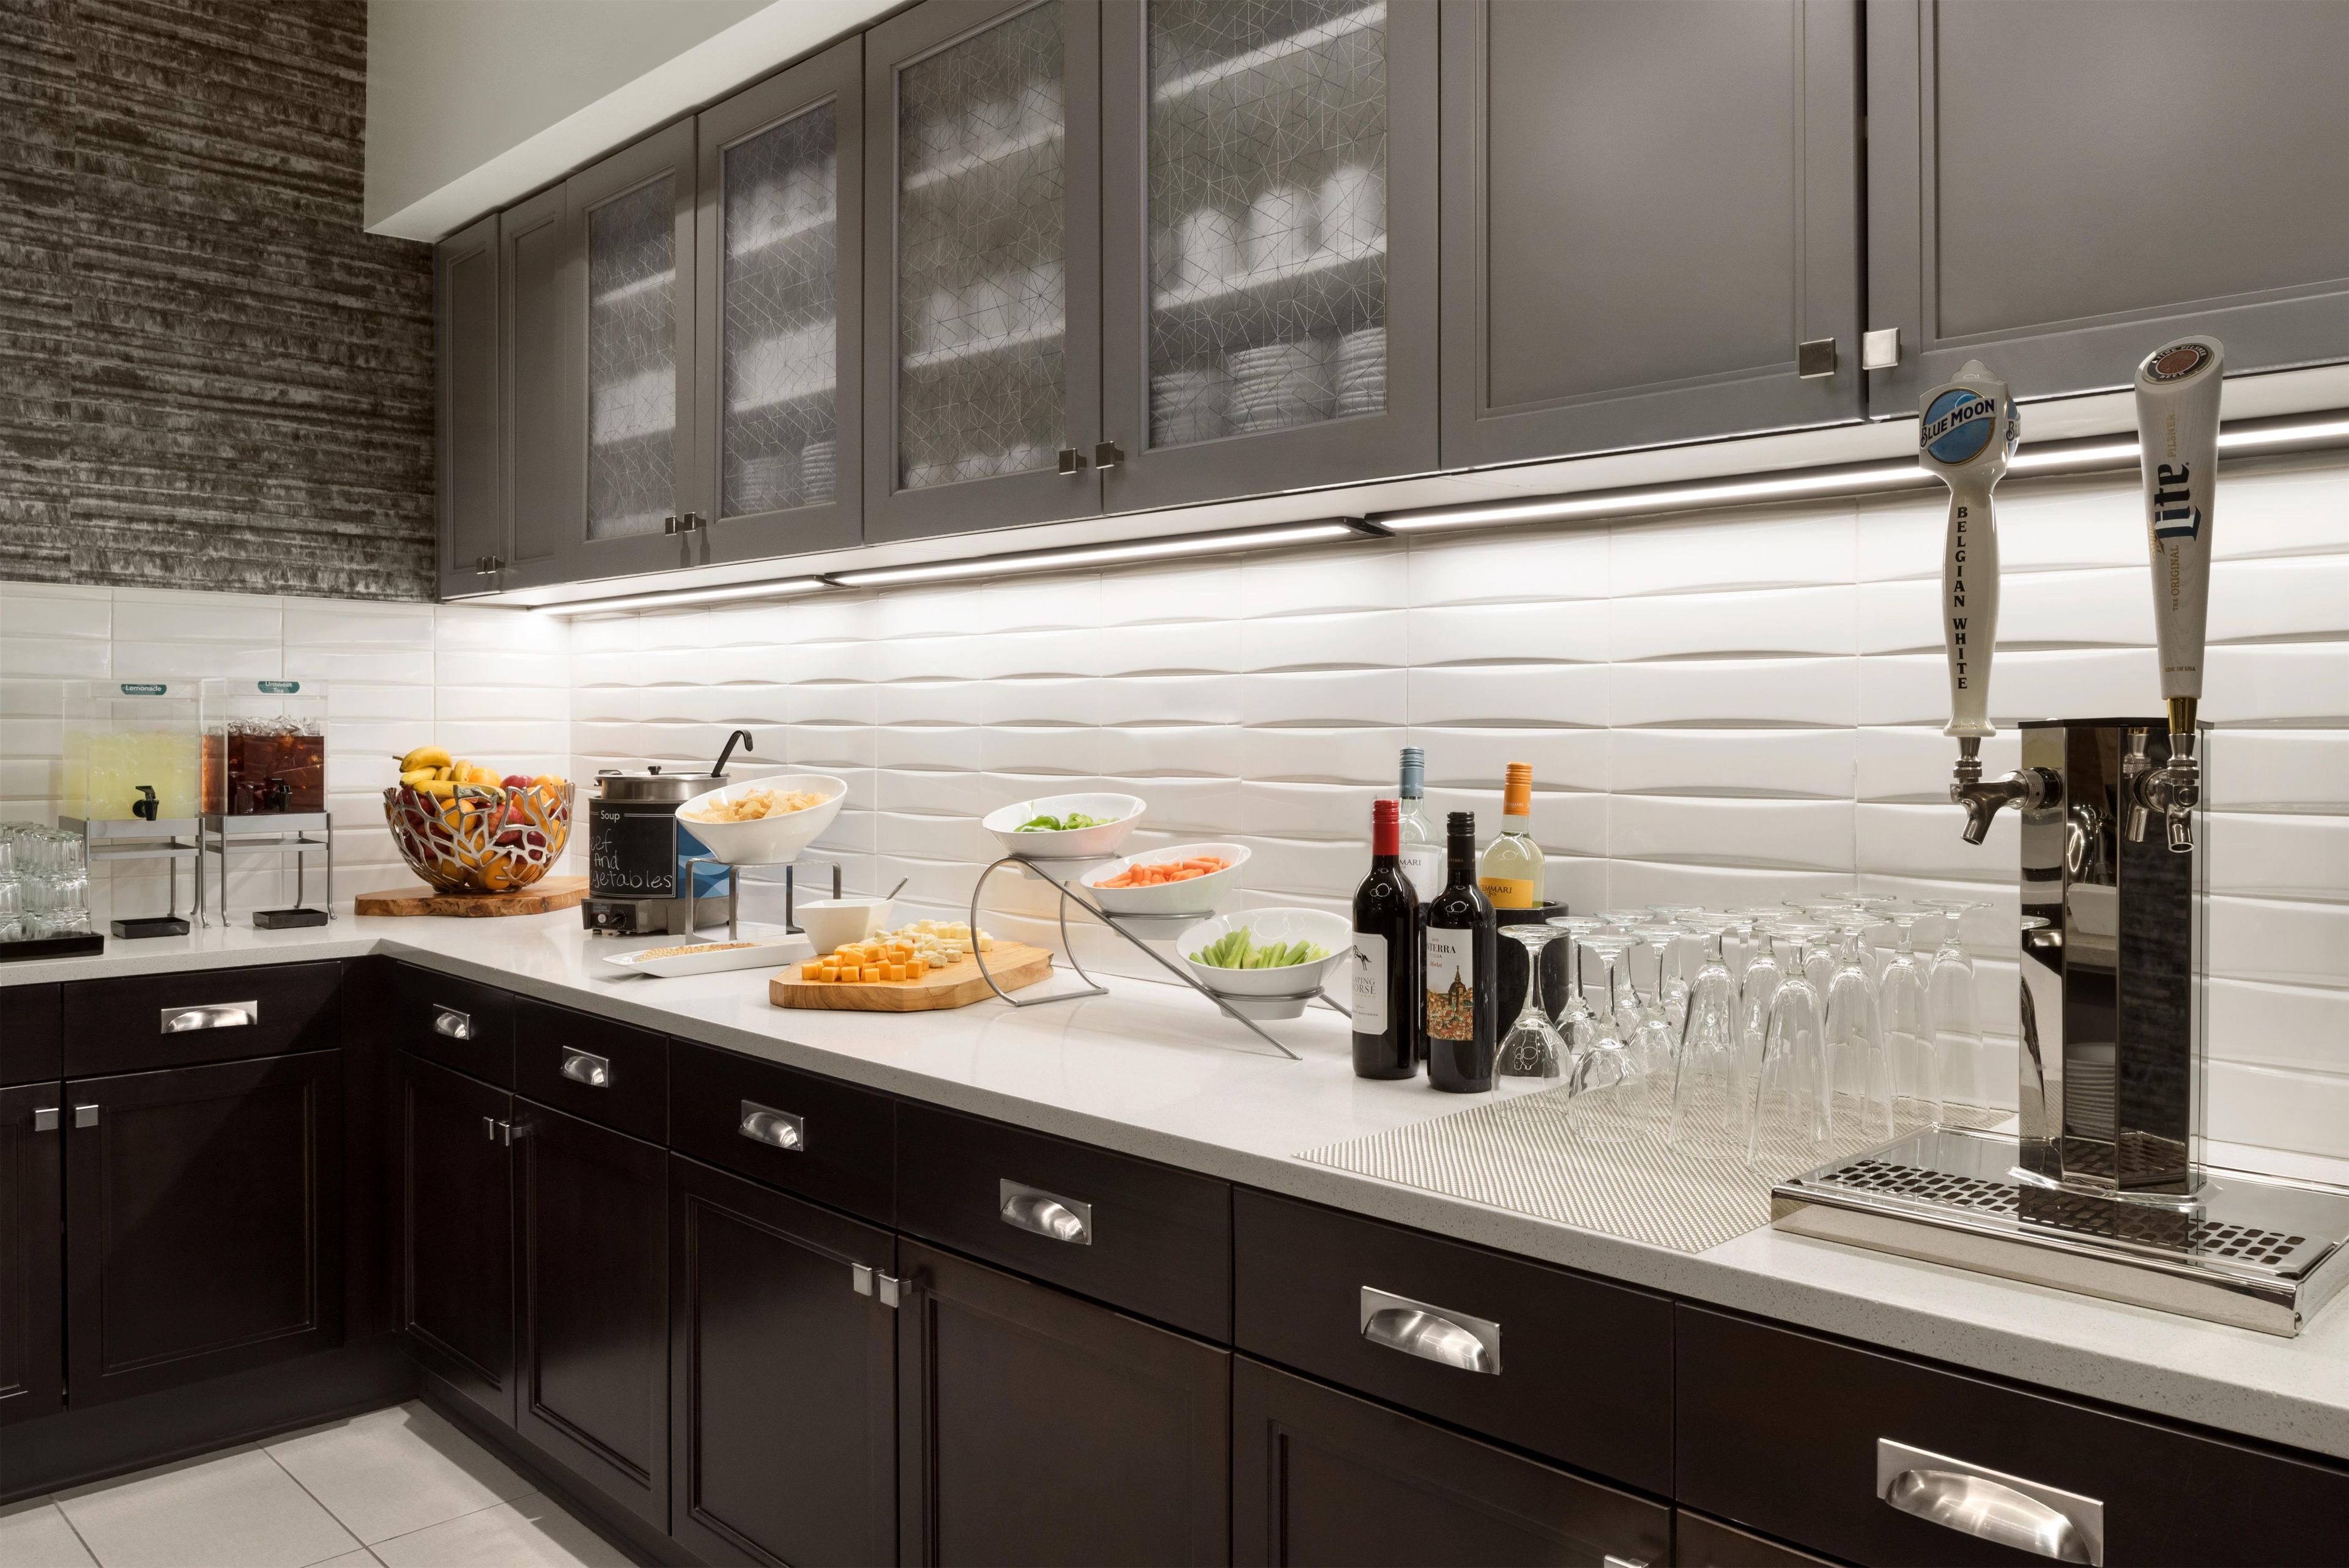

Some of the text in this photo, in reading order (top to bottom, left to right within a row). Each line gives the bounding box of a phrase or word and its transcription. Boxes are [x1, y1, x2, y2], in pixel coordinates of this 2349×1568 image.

[2181, 346, 2206, 356] PILSNER
[1920, 399, 1995, 447] BLUE MOON
[2166, 414, 2176, 457] PILSNER
[2154, 464, 2202, 541] Lite
[2170, 545, 2180, 596] ORIGINAL
[1952, 506, 1969, 689] BELGIAN WHITE
[601, 810, 620, 823] Soup
[589, 828, 612, 852] eef
[590, 870, 672, 889] getables
[1480, 884, 1512, 894] TEMMARI
